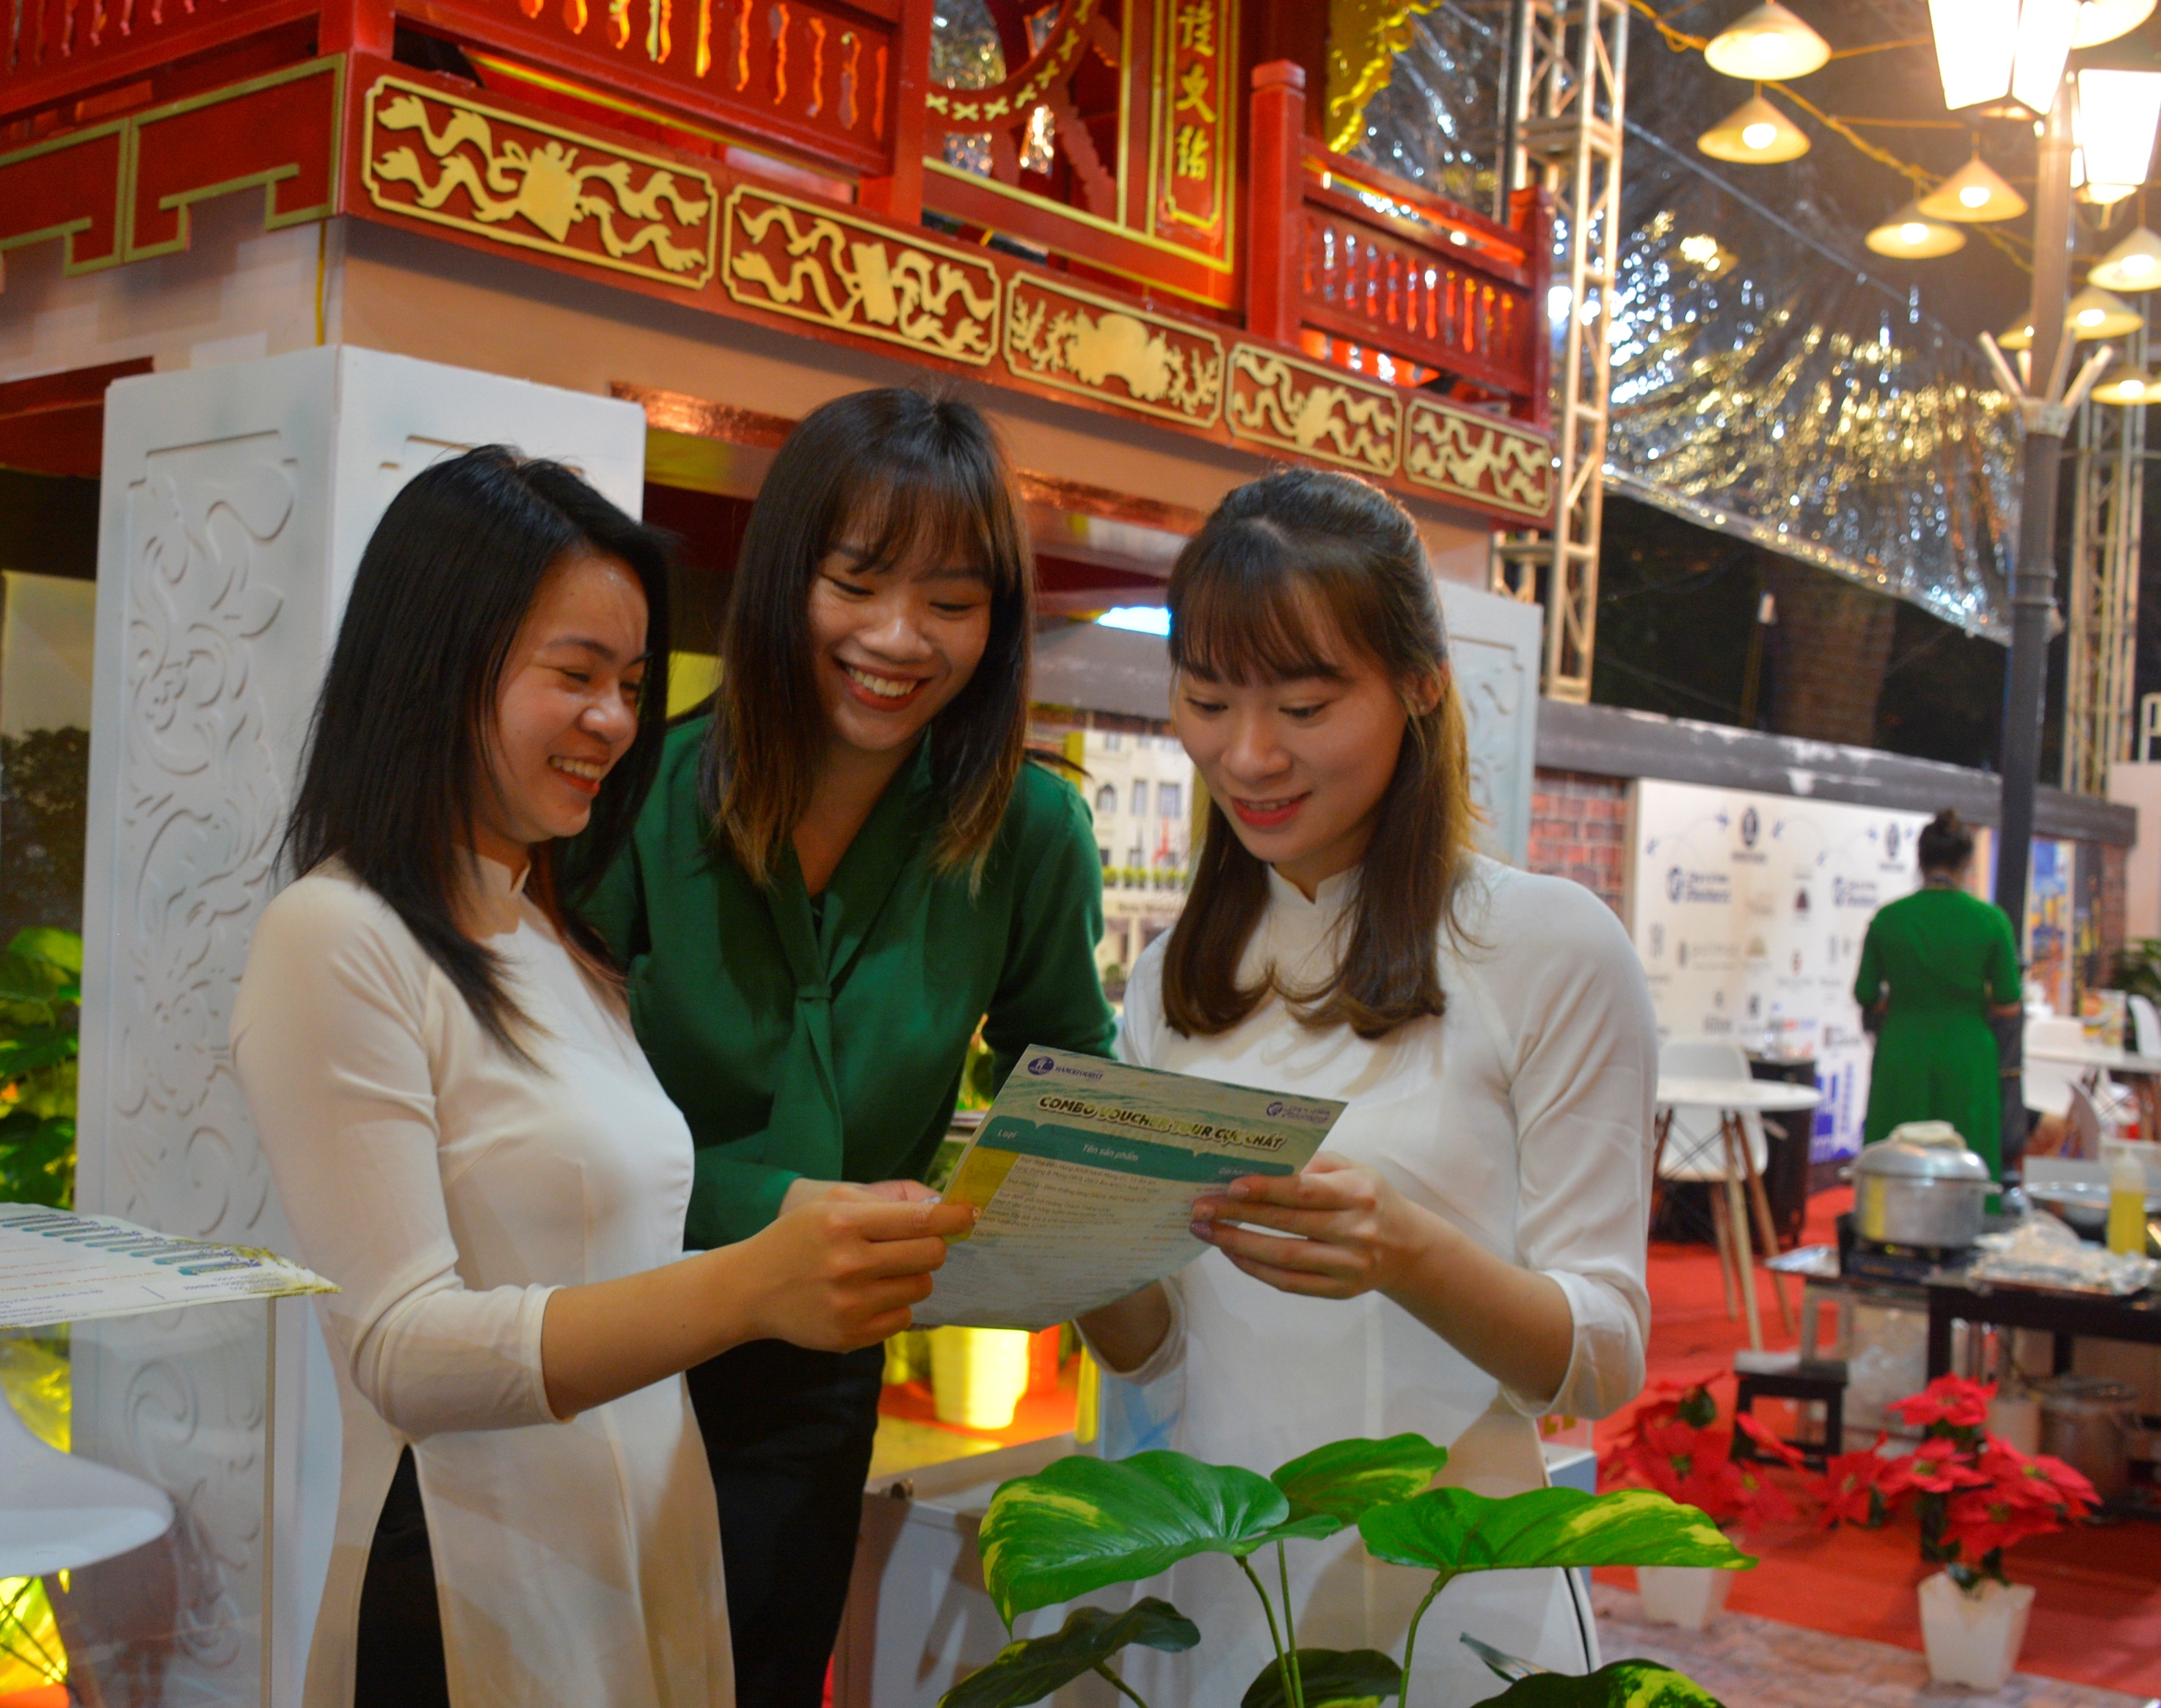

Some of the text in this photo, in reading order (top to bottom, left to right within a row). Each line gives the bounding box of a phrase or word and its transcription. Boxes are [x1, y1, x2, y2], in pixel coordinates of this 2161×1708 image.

[1038, 1095, 1097, 1117] COMBO
[1098, 1106, 1170, 1131] VOUCHER
[1170, 1120, 1214, 1139] TOUR
[1082, 1143, 1098, 1154] Tên
[1099, 1147, 1115, 1157] sản
[1114, 1150, 1140, 1162] phẩm
